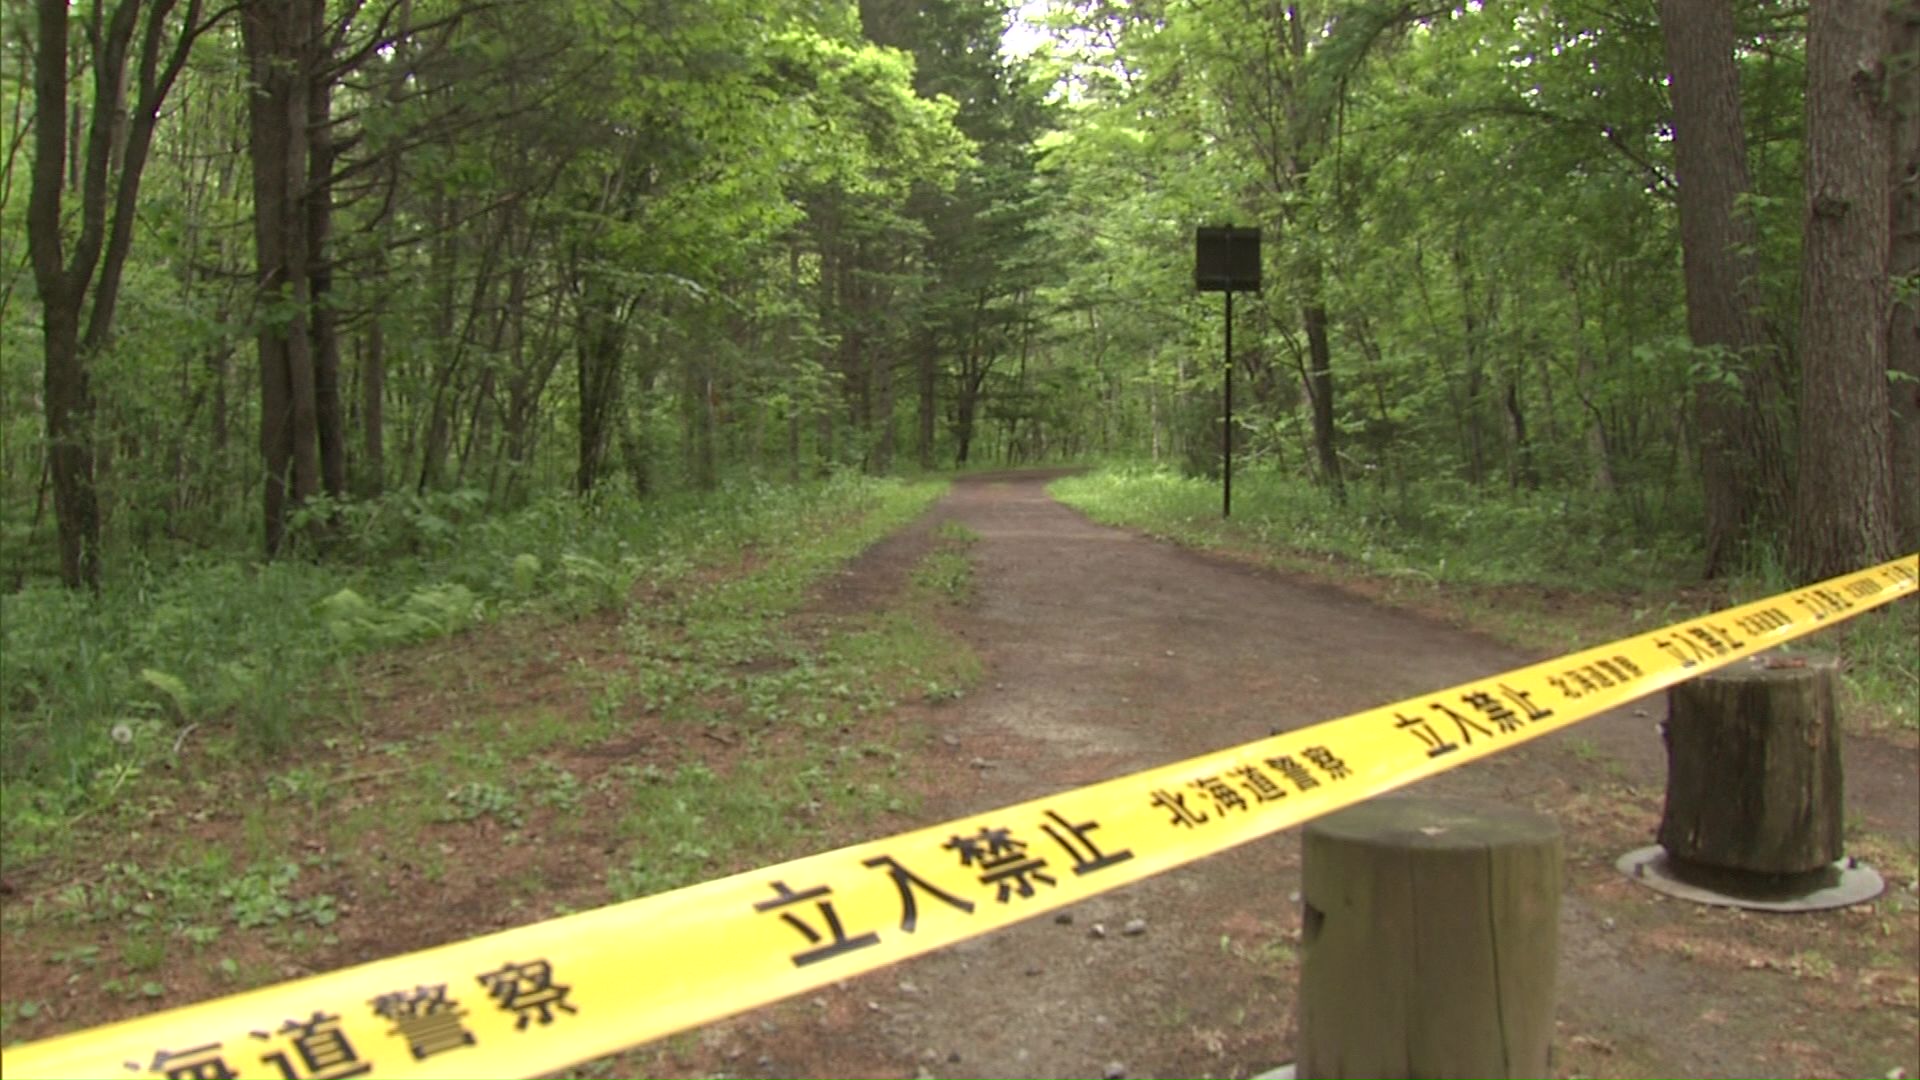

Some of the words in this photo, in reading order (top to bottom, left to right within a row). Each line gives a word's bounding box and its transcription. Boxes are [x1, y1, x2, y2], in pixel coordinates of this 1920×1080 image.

[754, 816, 1135, 967] 立入禁止
[1151, 746, 1353, 828] 北海道警察
[1394, 683, 1554, 758] 立入禁止
